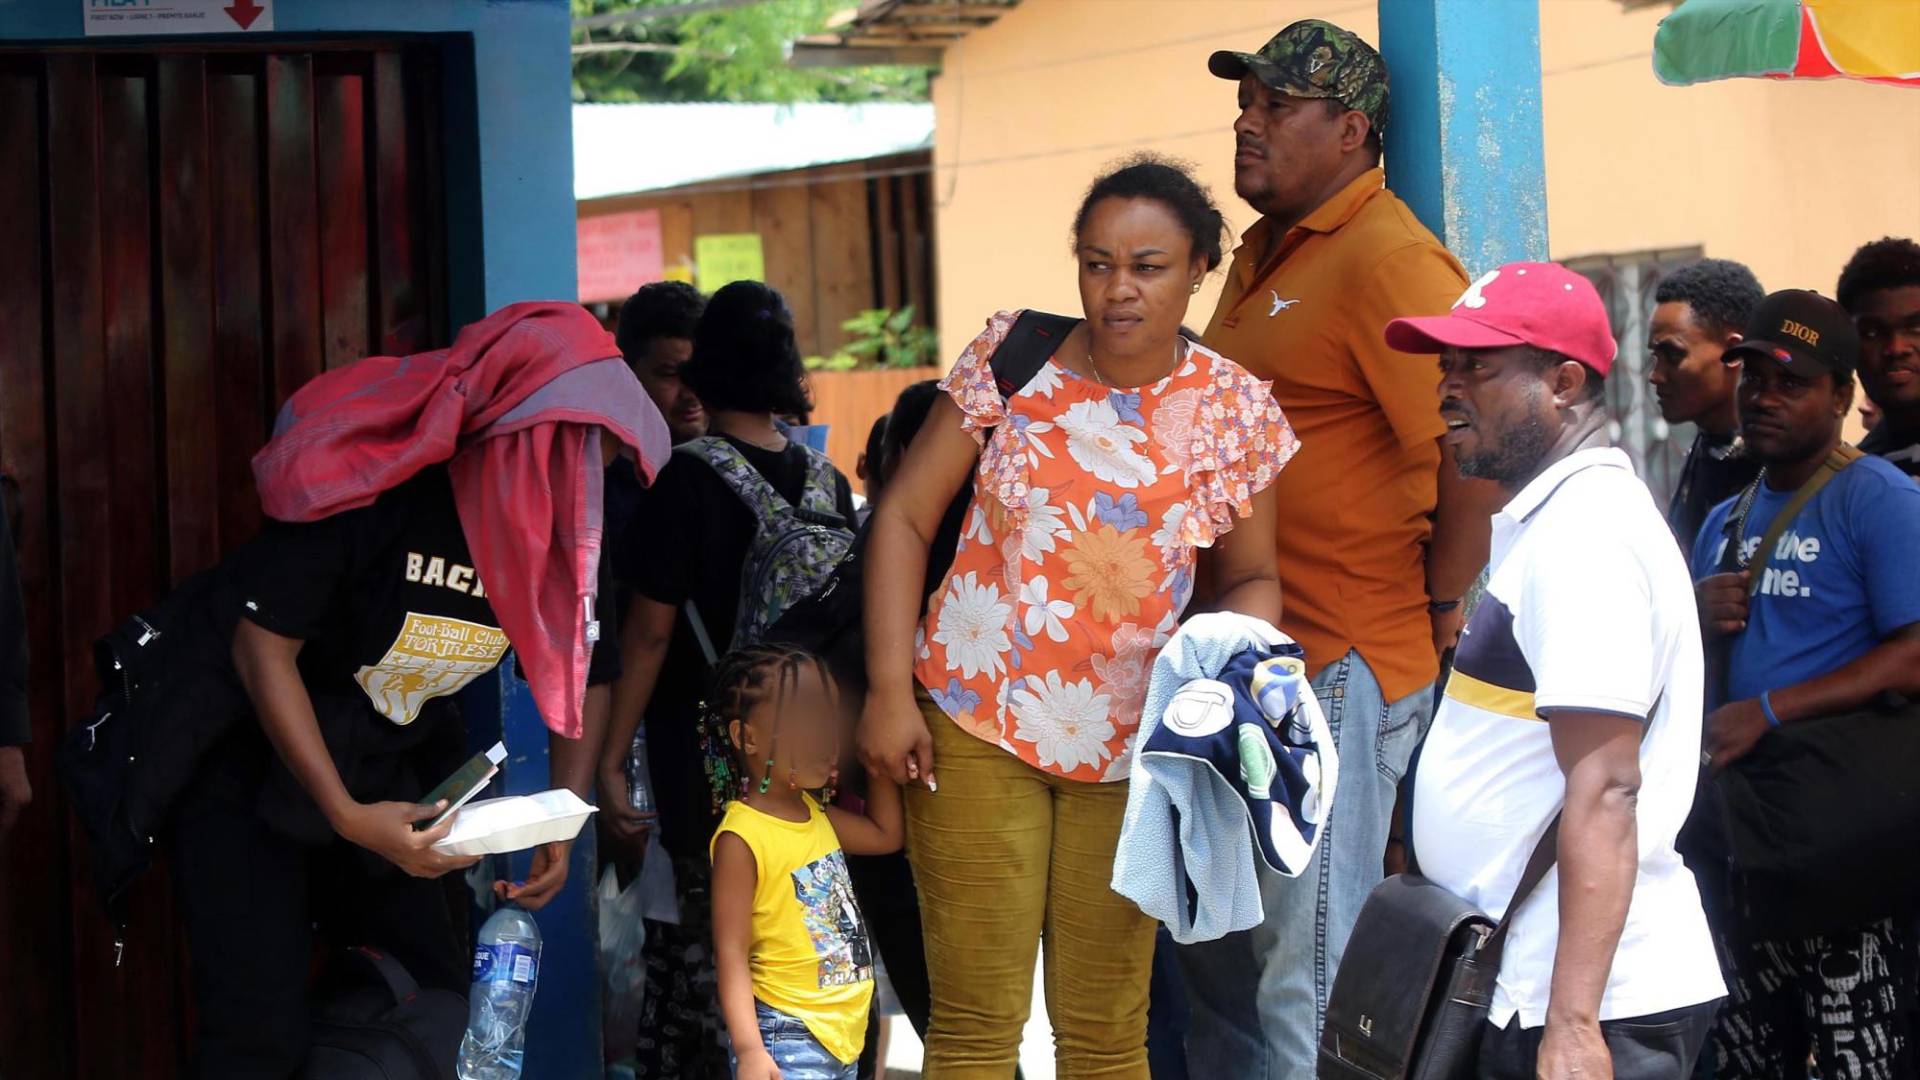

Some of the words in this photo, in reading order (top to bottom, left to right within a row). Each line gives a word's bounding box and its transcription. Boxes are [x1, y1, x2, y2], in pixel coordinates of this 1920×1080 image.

[1780, 319, 1819, 347] DIOR
[1775, 530, 1821, 562] the
[474, 629, 506, 646] Club
